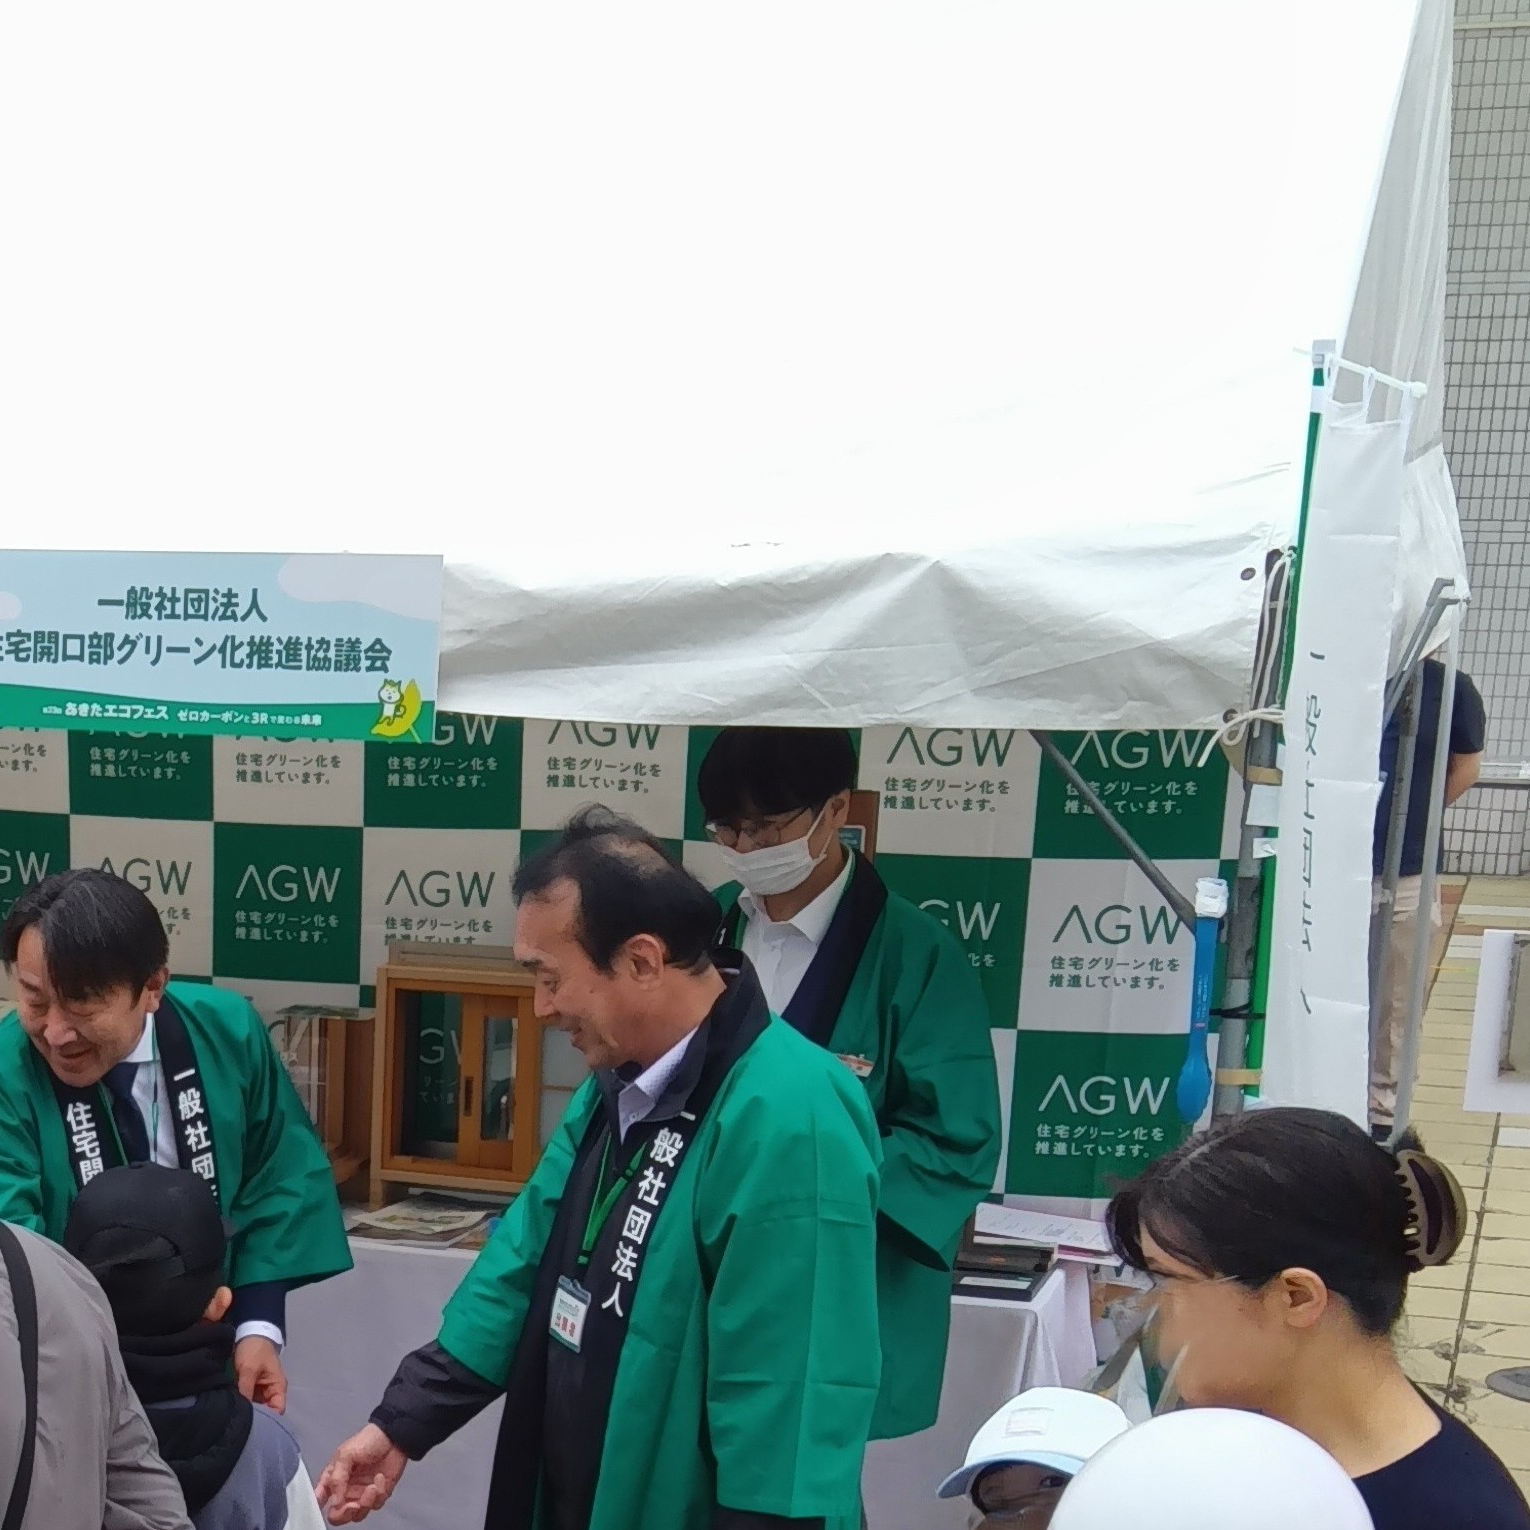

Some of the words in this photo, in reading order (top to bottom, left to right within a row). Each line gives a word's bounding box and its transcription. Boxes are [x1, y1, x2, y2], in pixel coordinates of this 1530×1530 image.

[97, 586, 268, 623] 一般社団法人
[65, 702, 169, 720] あきたエコフェス
[547, 720, 660, 750] AGW
[90, 746, 191, 764] 住宅グリーン化を
[886, 726, 1015, 768] AGW
[1072, 730, 1205, 769] AGW
[236, 752, 342, 769] 住宅グリーン化を
[387, 756, 498, 771] 住宅グリーン化を
[547, 756, 661, 777] 住宅グリーン化を
[90, 764, 182, 780] 推進しています。
[236, 769, 331, 785] 推進しています。
[387, 774, 487, 788] 推進しています。
[546, 774, 649, 793] 推進しています。
[884, 776, 1011, 795] 住宅グリーン化を
[883, 794, 997, 813] 推進しています。
[1064, 799, 1183, 815] 推ています。
[235, 865, 341, 903] AGW
[384, 870, 496, 907] AGW
[235, 910, 339, 927] 住宅グリーン化を
[384, 916, 493, 932] 住宅グリーン化を
[1053, 904, 1182, 945] AGW
[235, 926, 328, 943] 推進しています。
[1050, 956, 1180, 972] 住宅グリーン化を
[1049, 974, 1165, 990] 推進しています。
[1038, 1074, 1170, 1116] AGW
[1036, 1123, 1164, 1142] 住宅グリーン化を
[1034, 1141, 1149, 1159] 推進しています。
[601, 1110, 696, 1317] 一般社団法人
